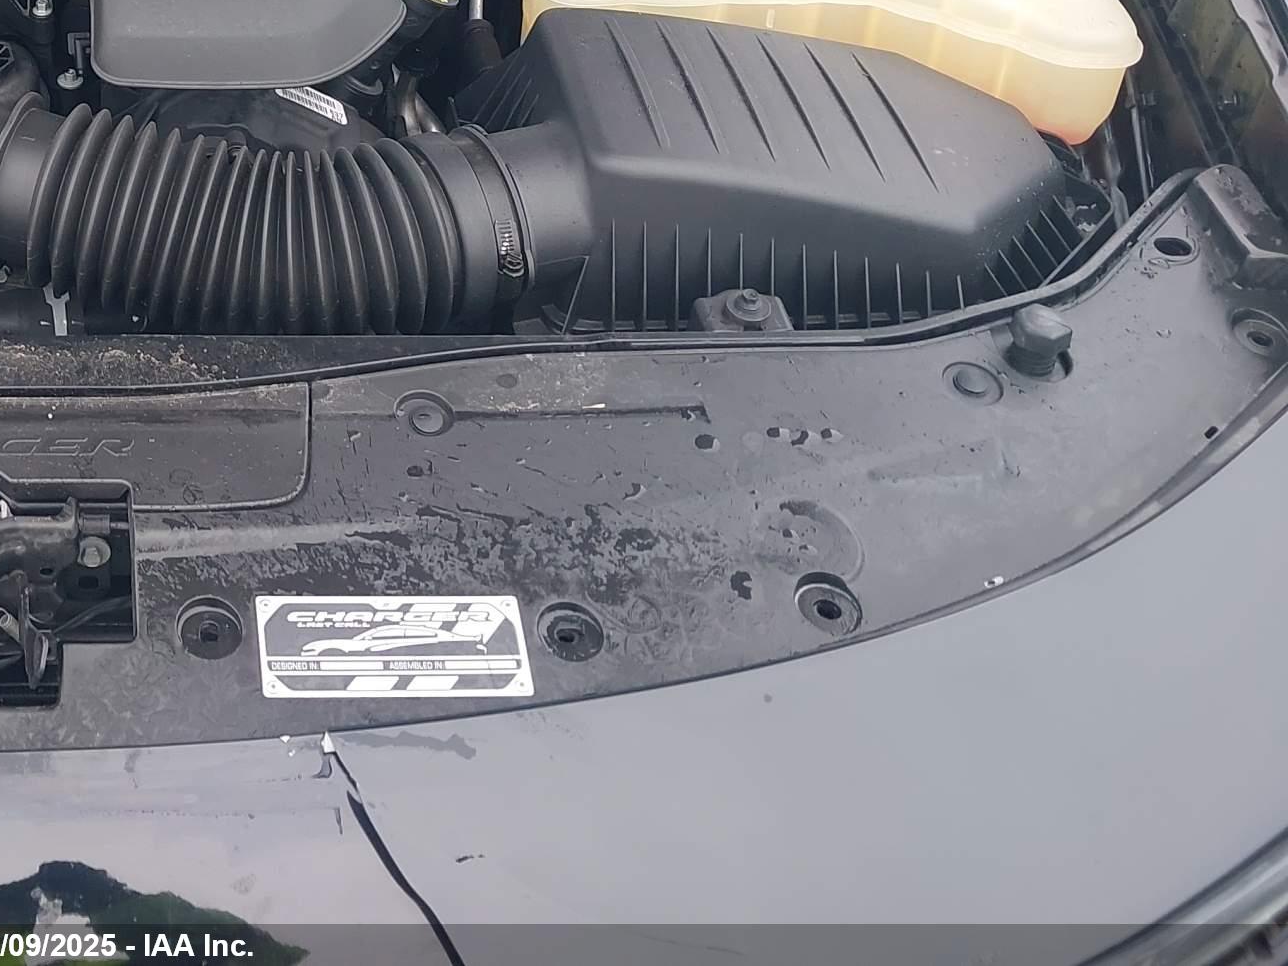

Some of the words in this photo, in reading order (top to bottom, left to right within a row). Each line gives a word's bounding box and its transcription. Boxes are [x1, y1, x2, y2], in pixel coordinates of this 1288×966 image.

[287, 611, 492, 622] CHARGER
[271, 661, 307, 671] DESIGNED
[389, 660, 432, 671] ASSEMBLED
